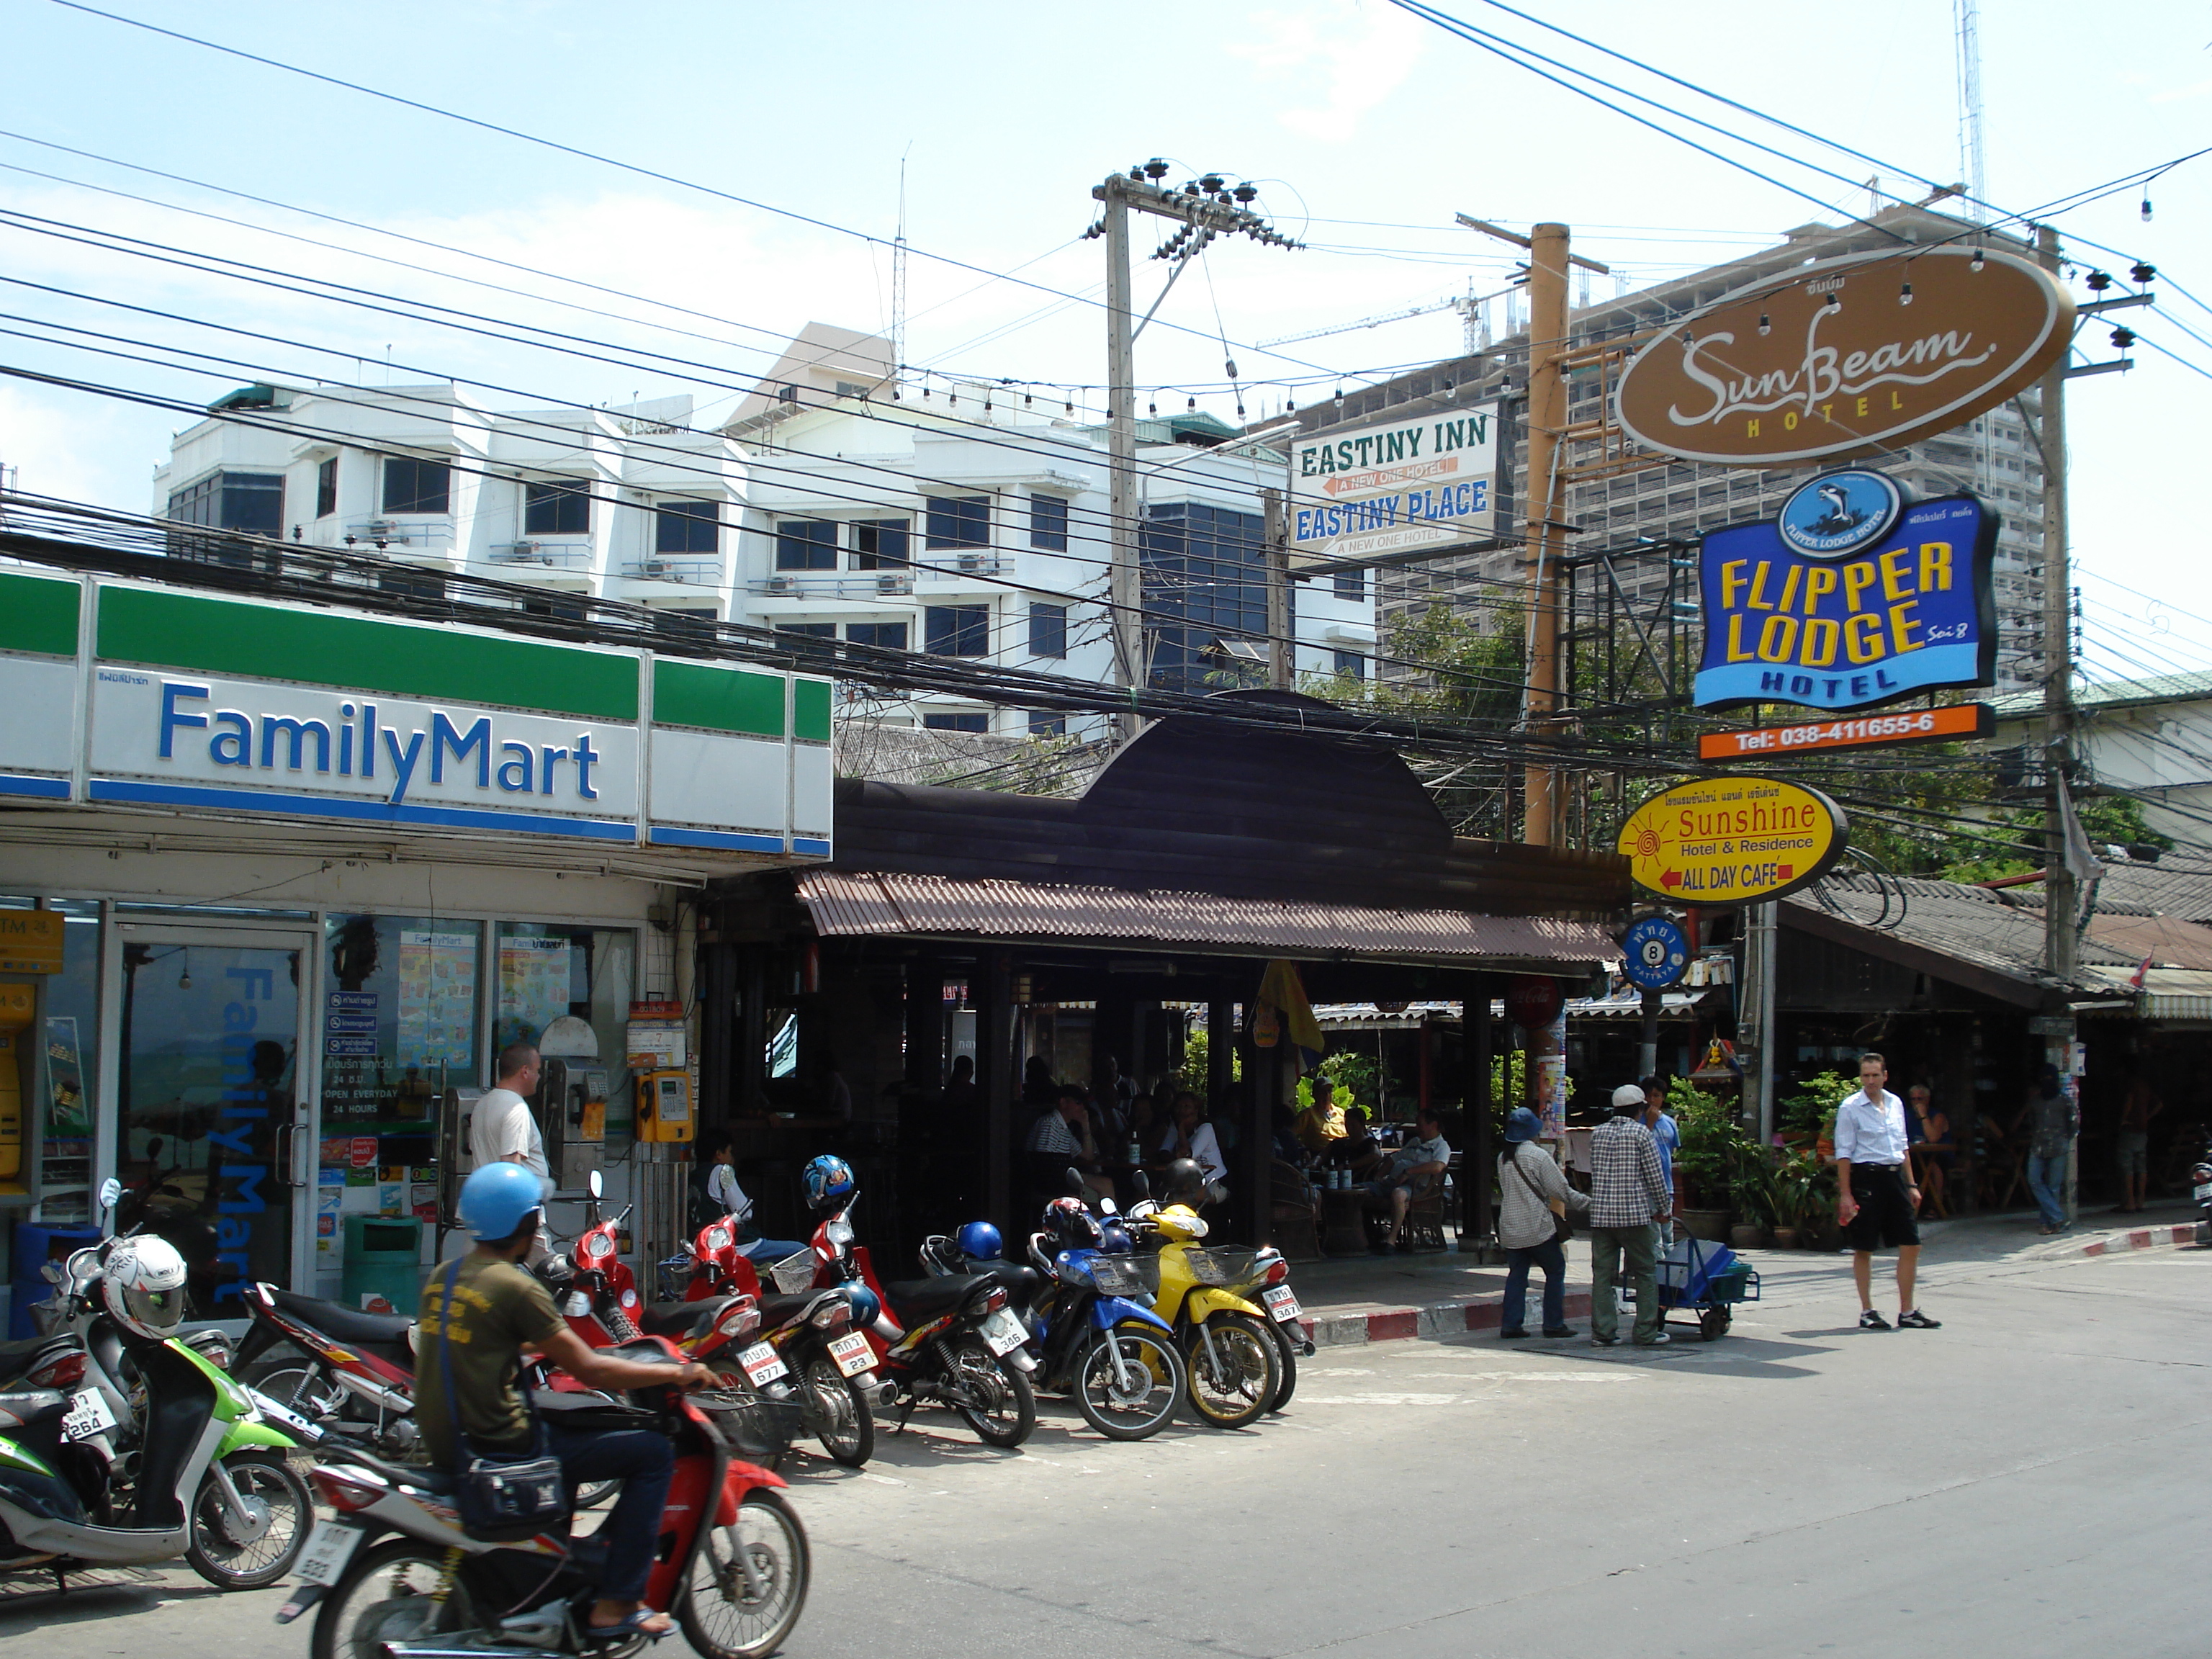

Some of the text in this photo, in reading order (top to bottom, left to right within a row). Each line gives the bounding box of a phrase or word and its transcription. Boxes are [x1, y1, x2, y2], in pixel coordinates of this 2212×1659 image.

[1747, 390, 1903, 439] HOTEL
[1300, 414, 1488, 477] EASTINY INN
[1339, 462, 1444, 491] A NEW ONE HOTEL
[1295, 479, 1488, 541] EASTINY PLACE
[1337, 529, 1442, 554] A NEW ONE HOTEL
[1786, 508, 1887, 548] FLIPPER LODGE HOTEL
[1721, 541, 1954, 616] FLIPPER
[1726, 599, 1925, 667] LODGE
[1927, 622, 1968, 642] Soi 8
[1760, 668, 1898, 698] HOTEL
[158, 679, 599, 804] FamilyMart
[1735, 713, 1935, 751] Tel: 038-411655-6
[1678, 801, 1816, 837] Sunshine
[1681, 837, 1814, 857] Hotel & Residence
[1682, 868, 1704, 891] ALL
[1710, 866, 1737, 889] DAY
[1649, 945, 1658, 959] 8
[1634, 966, 1673, 980] PATTAYA
[325, 1089, 398, 1099] OPEN EVERYDAY
[333, 1104, 378, 1114] 24 HOURS
[206, 967, 274, 1305] FamilyMart
[1277, 1306, 1295, 1318] 347
[1001, 1333, 1021, 1350] 346
[756, 1365, 778, 1382] 677
[850, 1357, 867, 1370] 23
